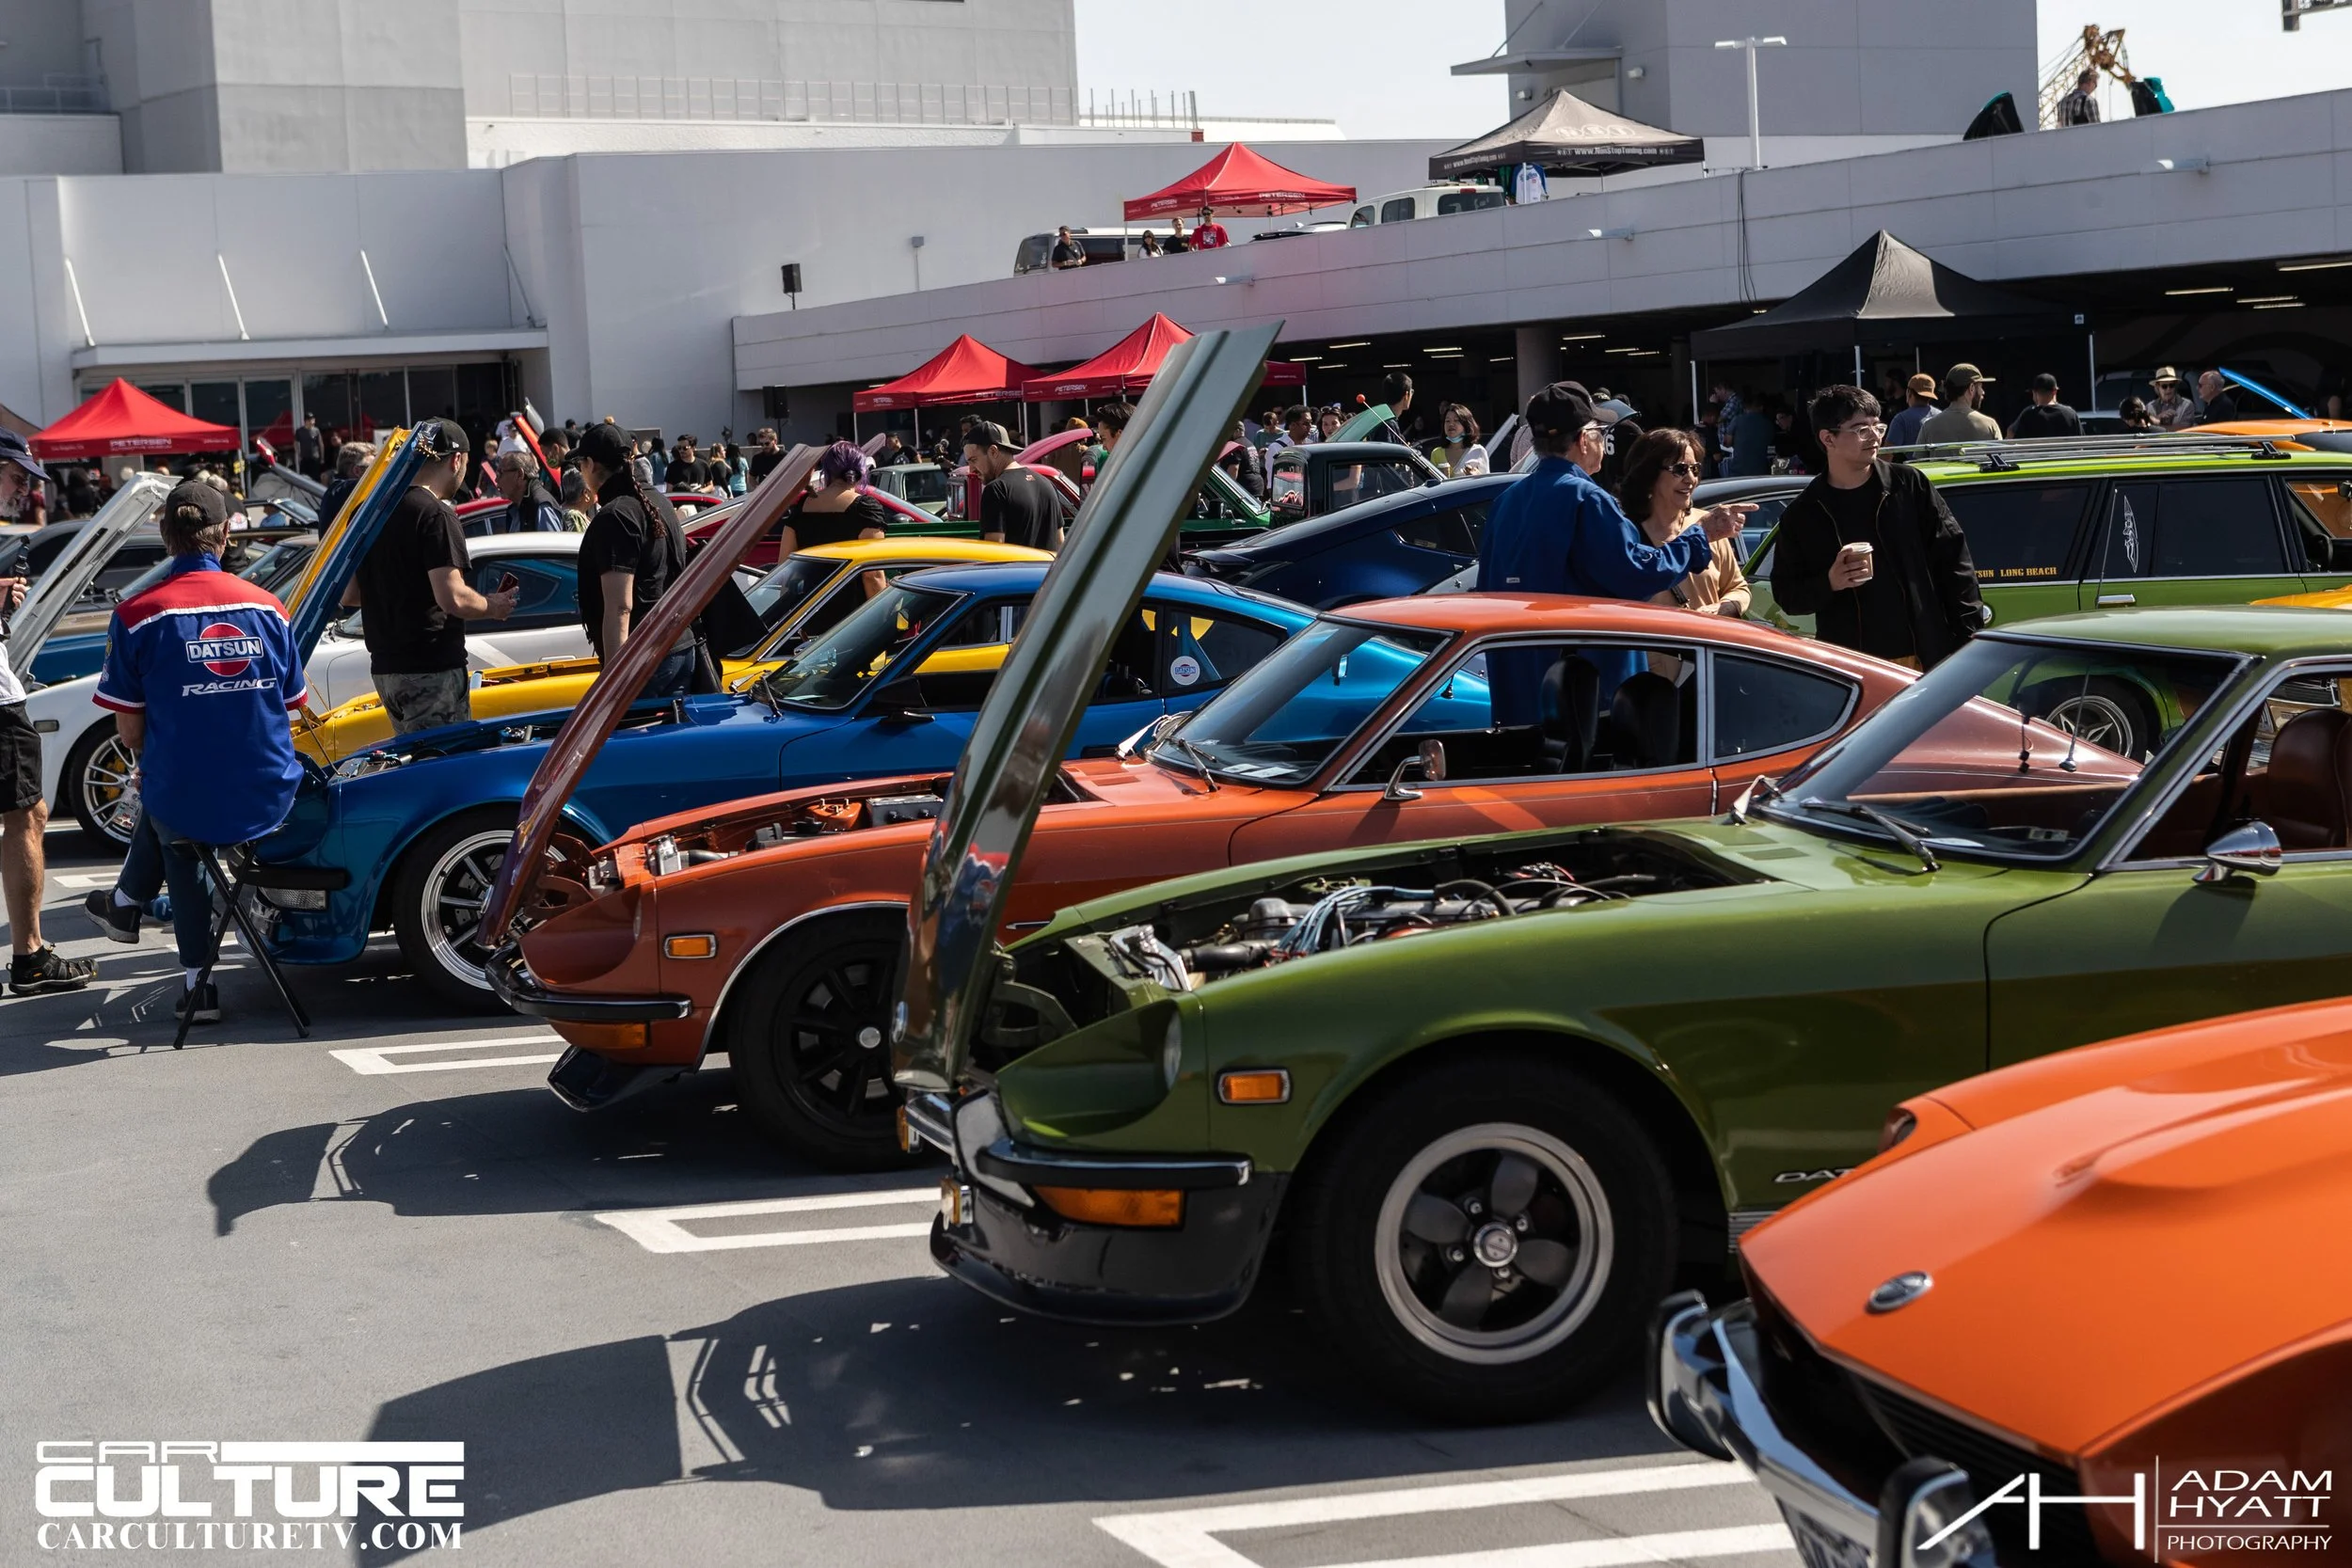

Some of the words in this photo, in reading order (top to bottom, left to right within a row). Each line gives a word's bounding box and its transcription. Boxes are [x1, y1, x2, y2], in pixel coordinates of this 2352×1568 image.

[109, 438, 172, 448] PETERSEN
[2000, 568, 2024, 578] LONG
[2026, 566, 2058, 576] BEACH
[188, 641, 262, 659] DATSUN
[182, 677, 278, 697] RACING
